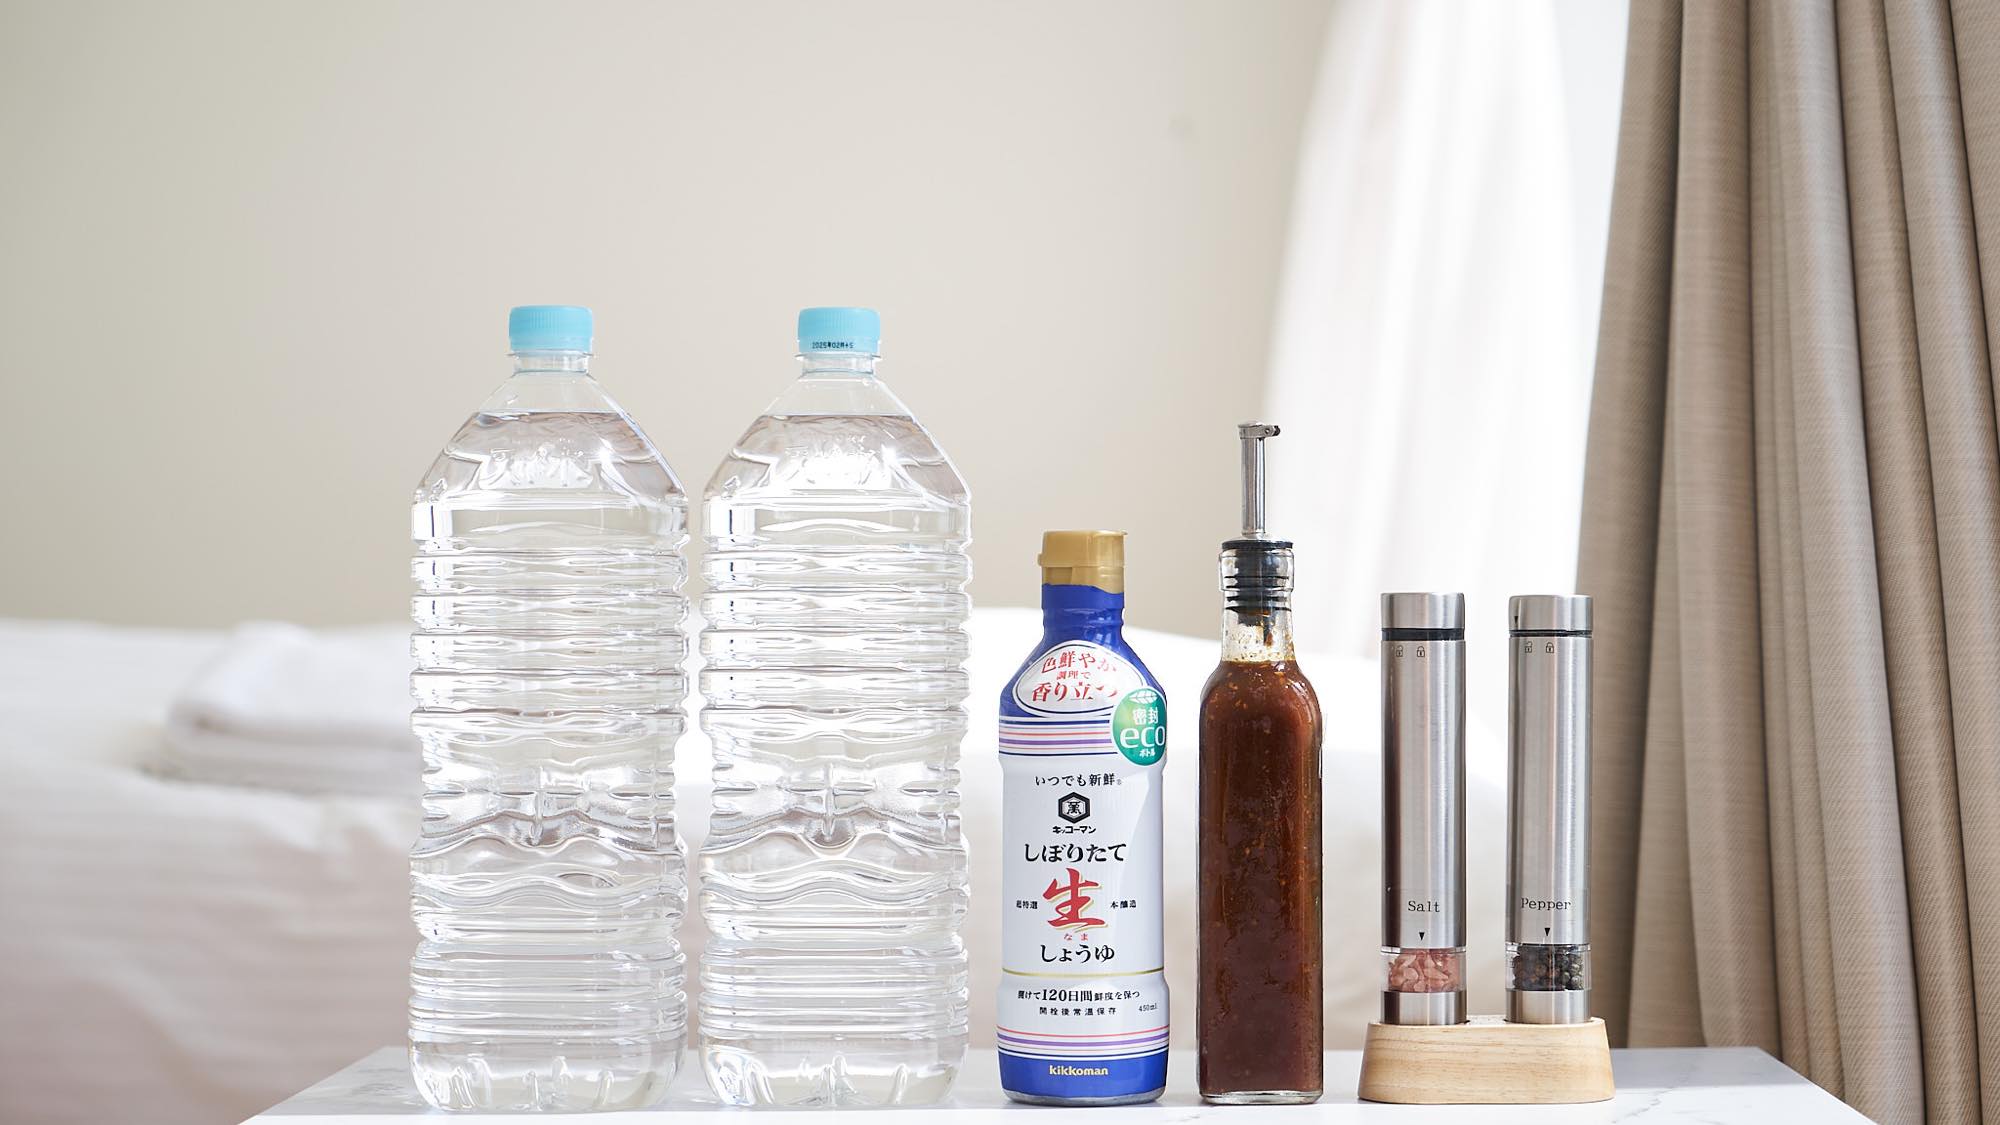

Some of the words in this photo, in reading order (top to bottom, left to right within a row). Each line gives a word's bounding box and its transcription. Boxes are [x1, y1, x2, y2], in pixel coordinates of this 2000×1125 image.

[1041, 651, 1117, 673] 色鮮やか
[1056, 670, 1092, 680] 調理で
[1132, 707, 1159, 725] 密封
[1119, 726, 1165, 749] eco
[1052, 825, 1097, 834] キッコーマン
[1024, 843, 1127, 862] しぼりたて
[1042, 867, 1106, 929] 生
[1520, 897, 1572, 911] Pepper
[1407, 900, 1441, 913] Salt
[1063, 933, 1089, 941] なま
[1040, 944, 1115, 963] しょうゆ
[1039, 1006, 1117, 1016] 開栓後常温保存
[1049, 1065, 1109, 1076] kikkoman
